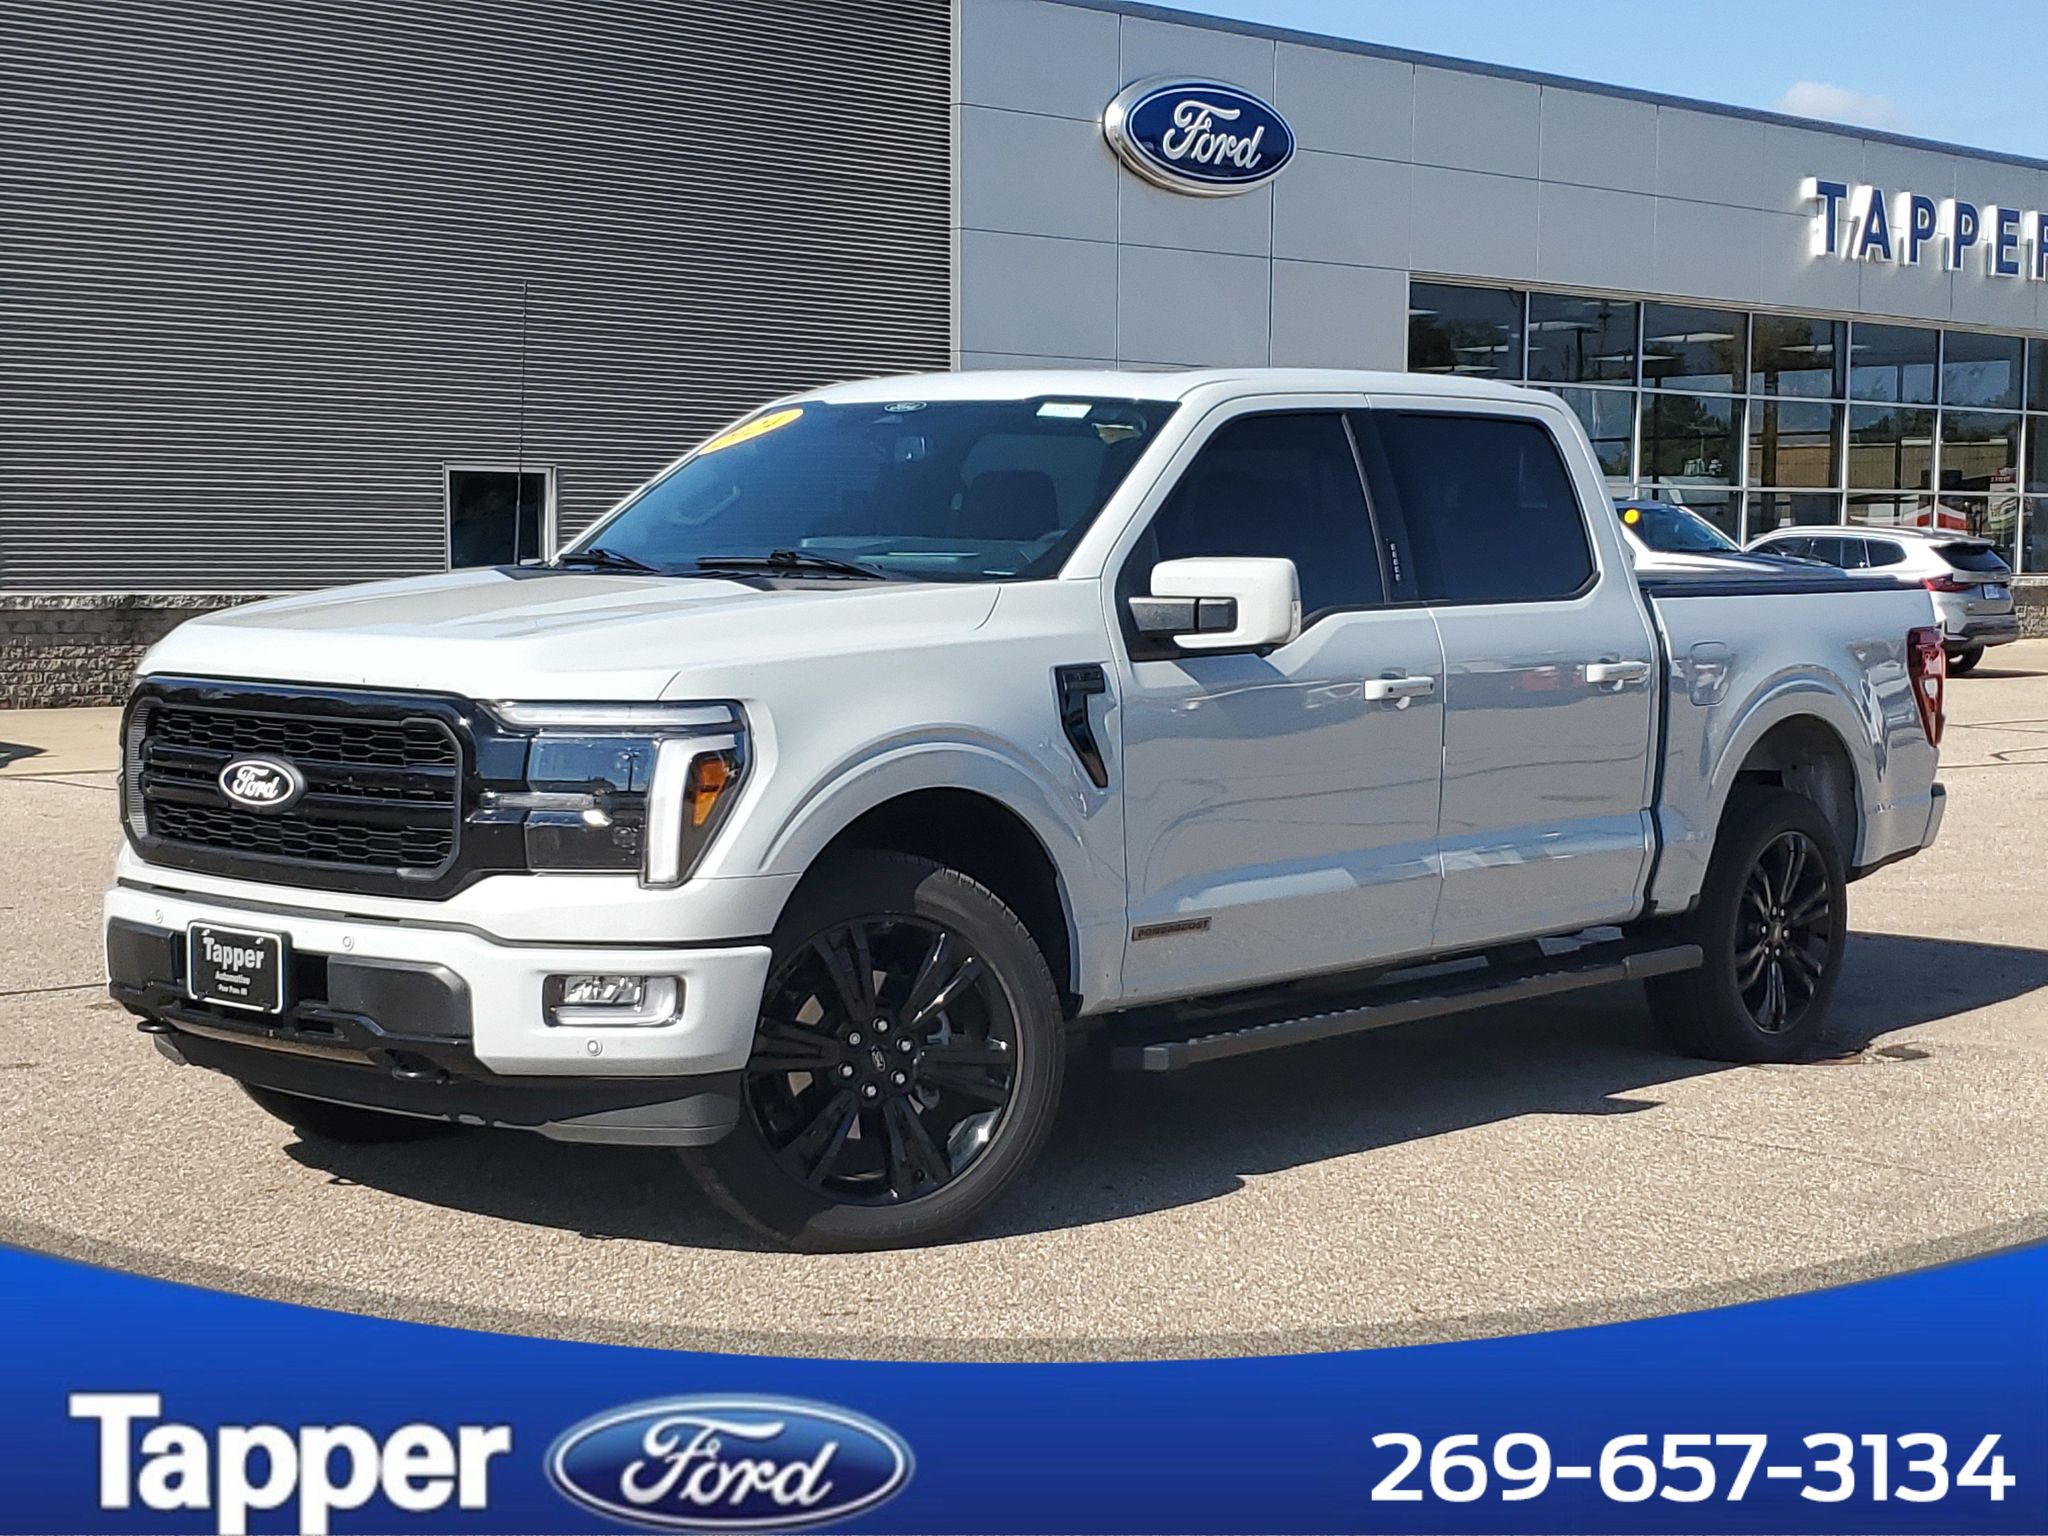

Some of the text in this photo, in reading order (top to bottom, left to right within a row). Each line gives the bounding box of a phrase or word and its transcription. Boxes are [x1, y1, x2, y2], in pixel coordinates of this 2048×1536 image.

[1163, 100, 1265, 169] Ford
[232, 765, 280, 799] Ford
[202, 936, 265, 972] Tapper
